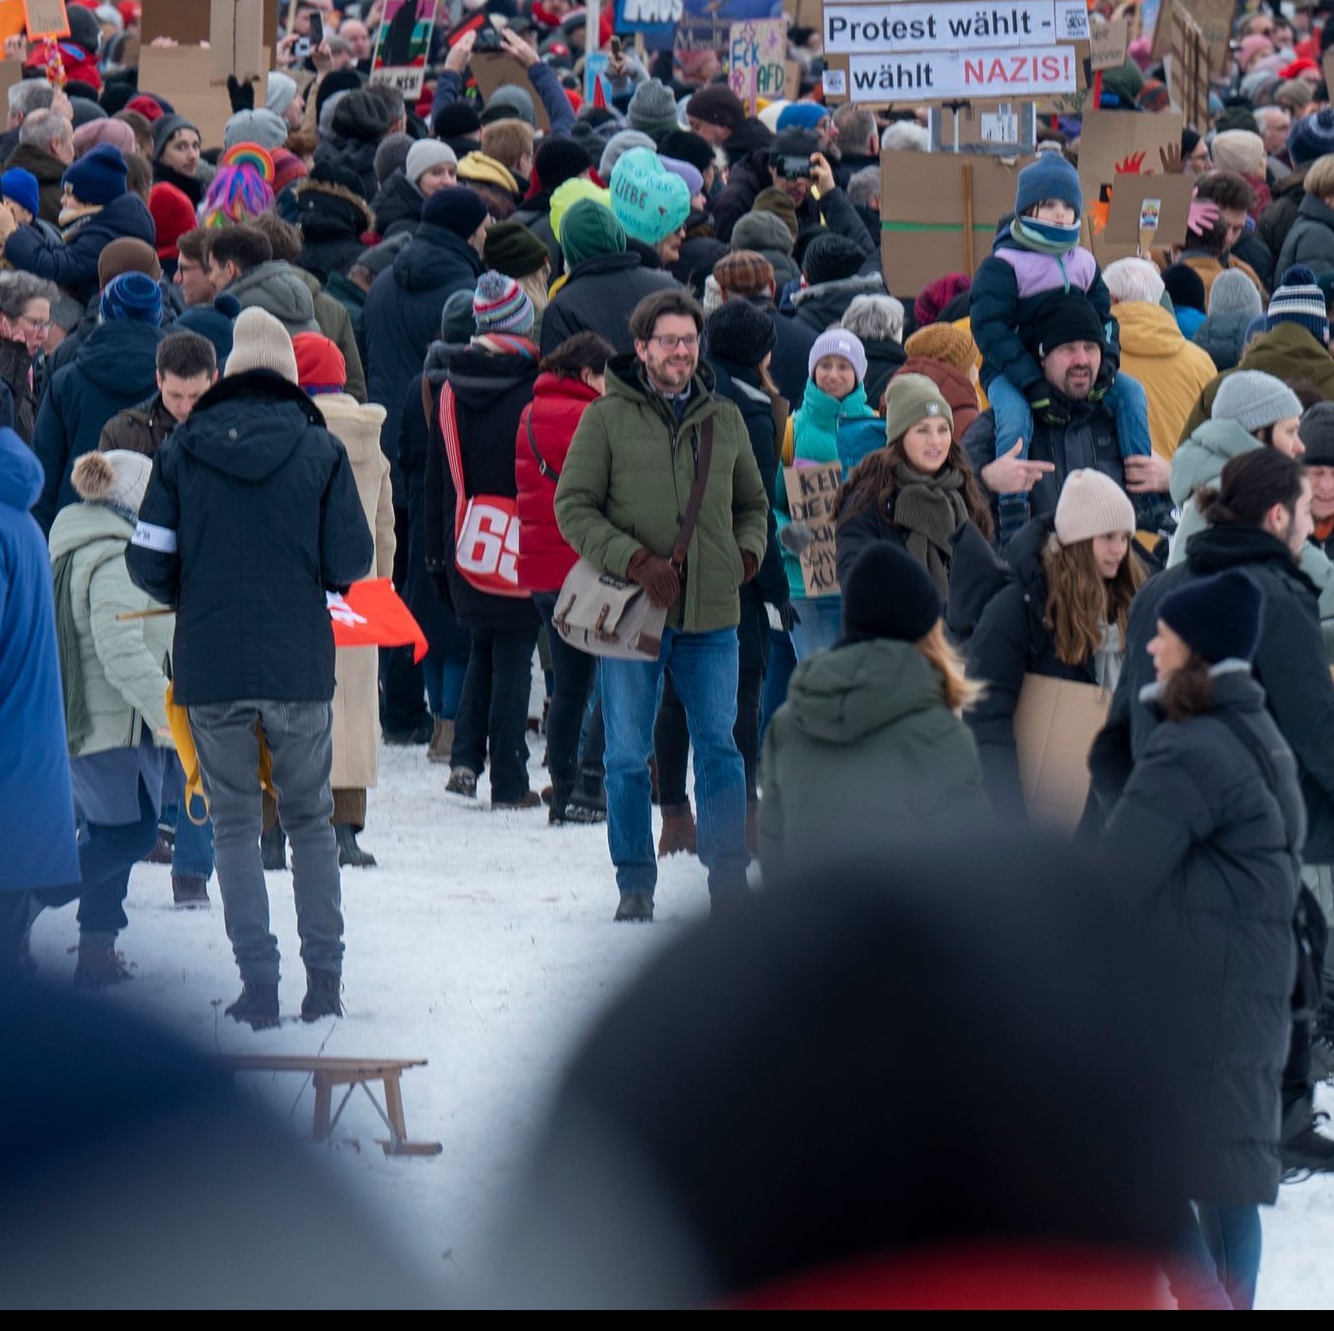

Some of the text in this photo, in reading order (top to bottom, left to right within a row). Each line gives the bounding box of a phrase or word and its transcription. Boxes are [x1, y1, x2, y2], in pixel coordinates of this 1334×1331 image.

[828, 14, 938, 42] Protest
[948, 9, 1032, 39] wählt
[757, 65, 785, 94] AFD
[852, 56, 1071, 91] wählt NAZIS!
[615, 174, 649, 210] LIEBE
